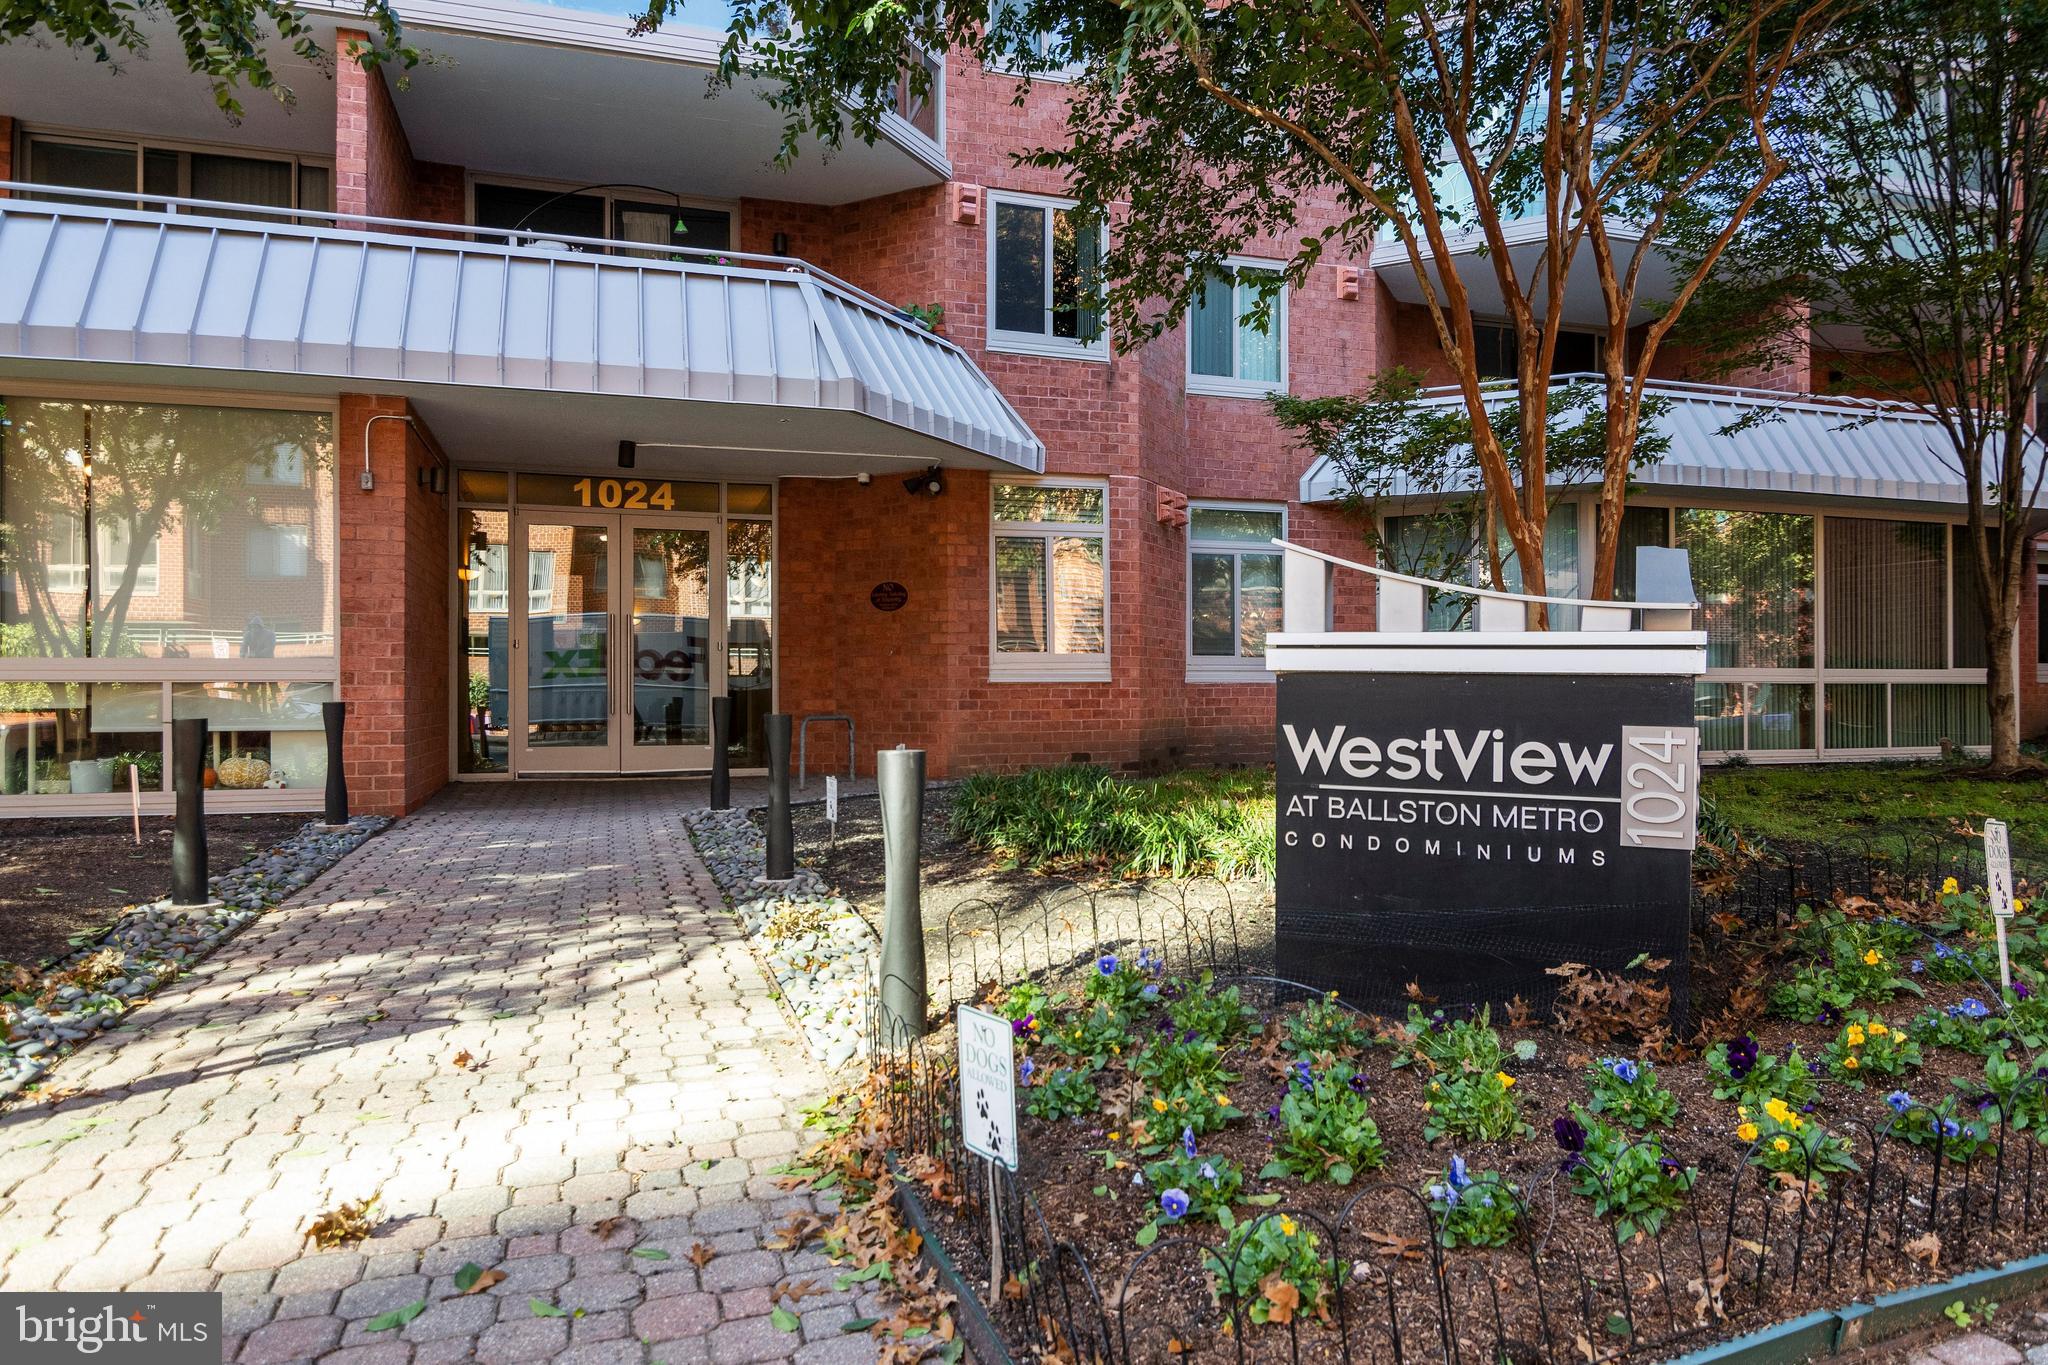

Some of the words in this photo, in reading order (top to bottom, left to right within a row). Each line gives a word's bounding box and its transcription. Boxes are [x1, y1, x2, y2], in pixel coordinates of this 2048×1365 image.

[573, 479, 675, 510] 1024
[1282, 724, 1614, 786] WestView
[1626, 730, 1687, 845] 1024
[1286, 795, 1318, 817] AT
[1328, 797, 1481, 827] BALLSTON
[1493, 805, 1603, 833] METRO
[1285, 831, 1605, 866] CONDOMINIUMS
[971, 1021, 995, 1048] NO
[965, 1043, 1007, 1077] DOGS
[966, 1067, 1007, 1092] ALLOWED
